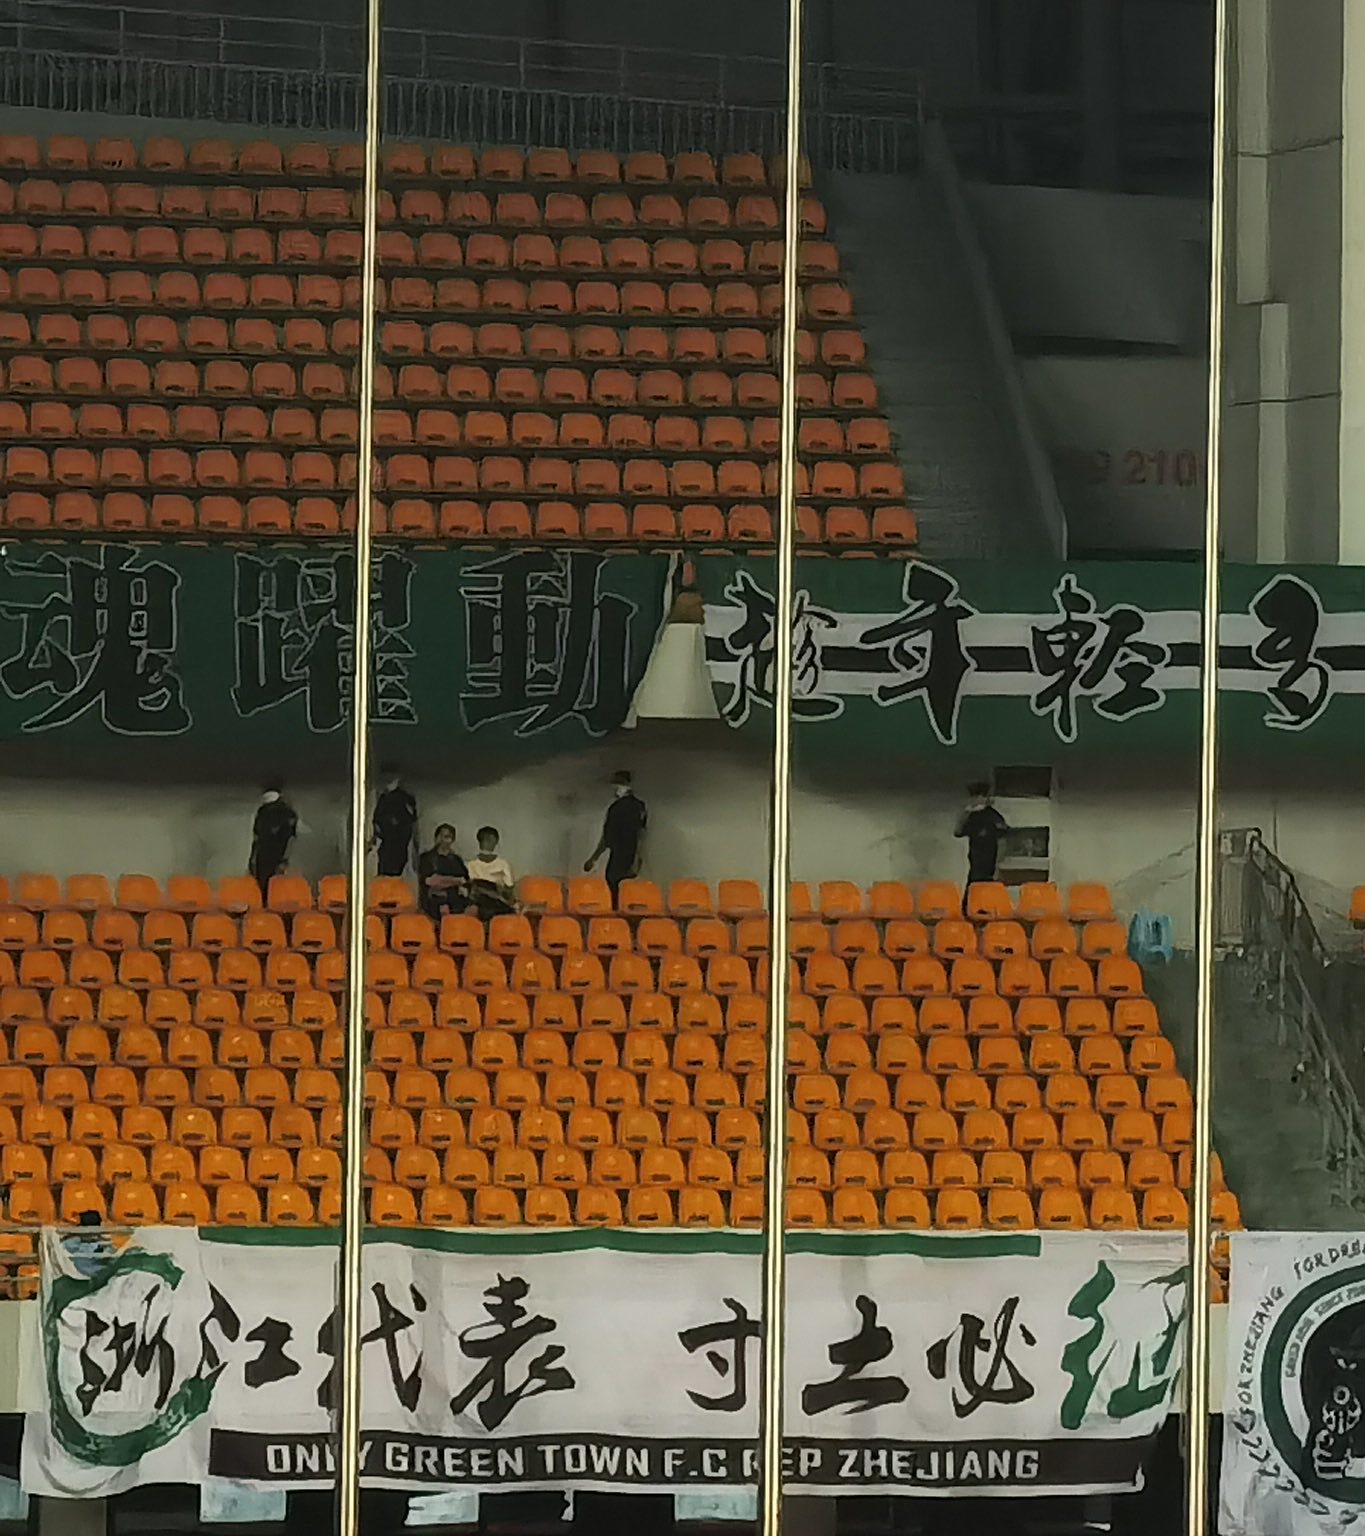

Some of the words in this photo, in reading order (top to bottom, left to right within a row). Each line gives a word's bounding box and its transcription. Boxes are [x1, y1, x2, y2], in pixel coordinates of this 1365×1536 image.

[80, 1272, 576, 1432] 浙江代表
[385, 1445, 525, 1478] GREEN
[537, 1445, 650, 1478] TOWN
[664, 1448, 727, 1477] F.C
[838, 1448, 1040, 1480] ZHEJIANG
